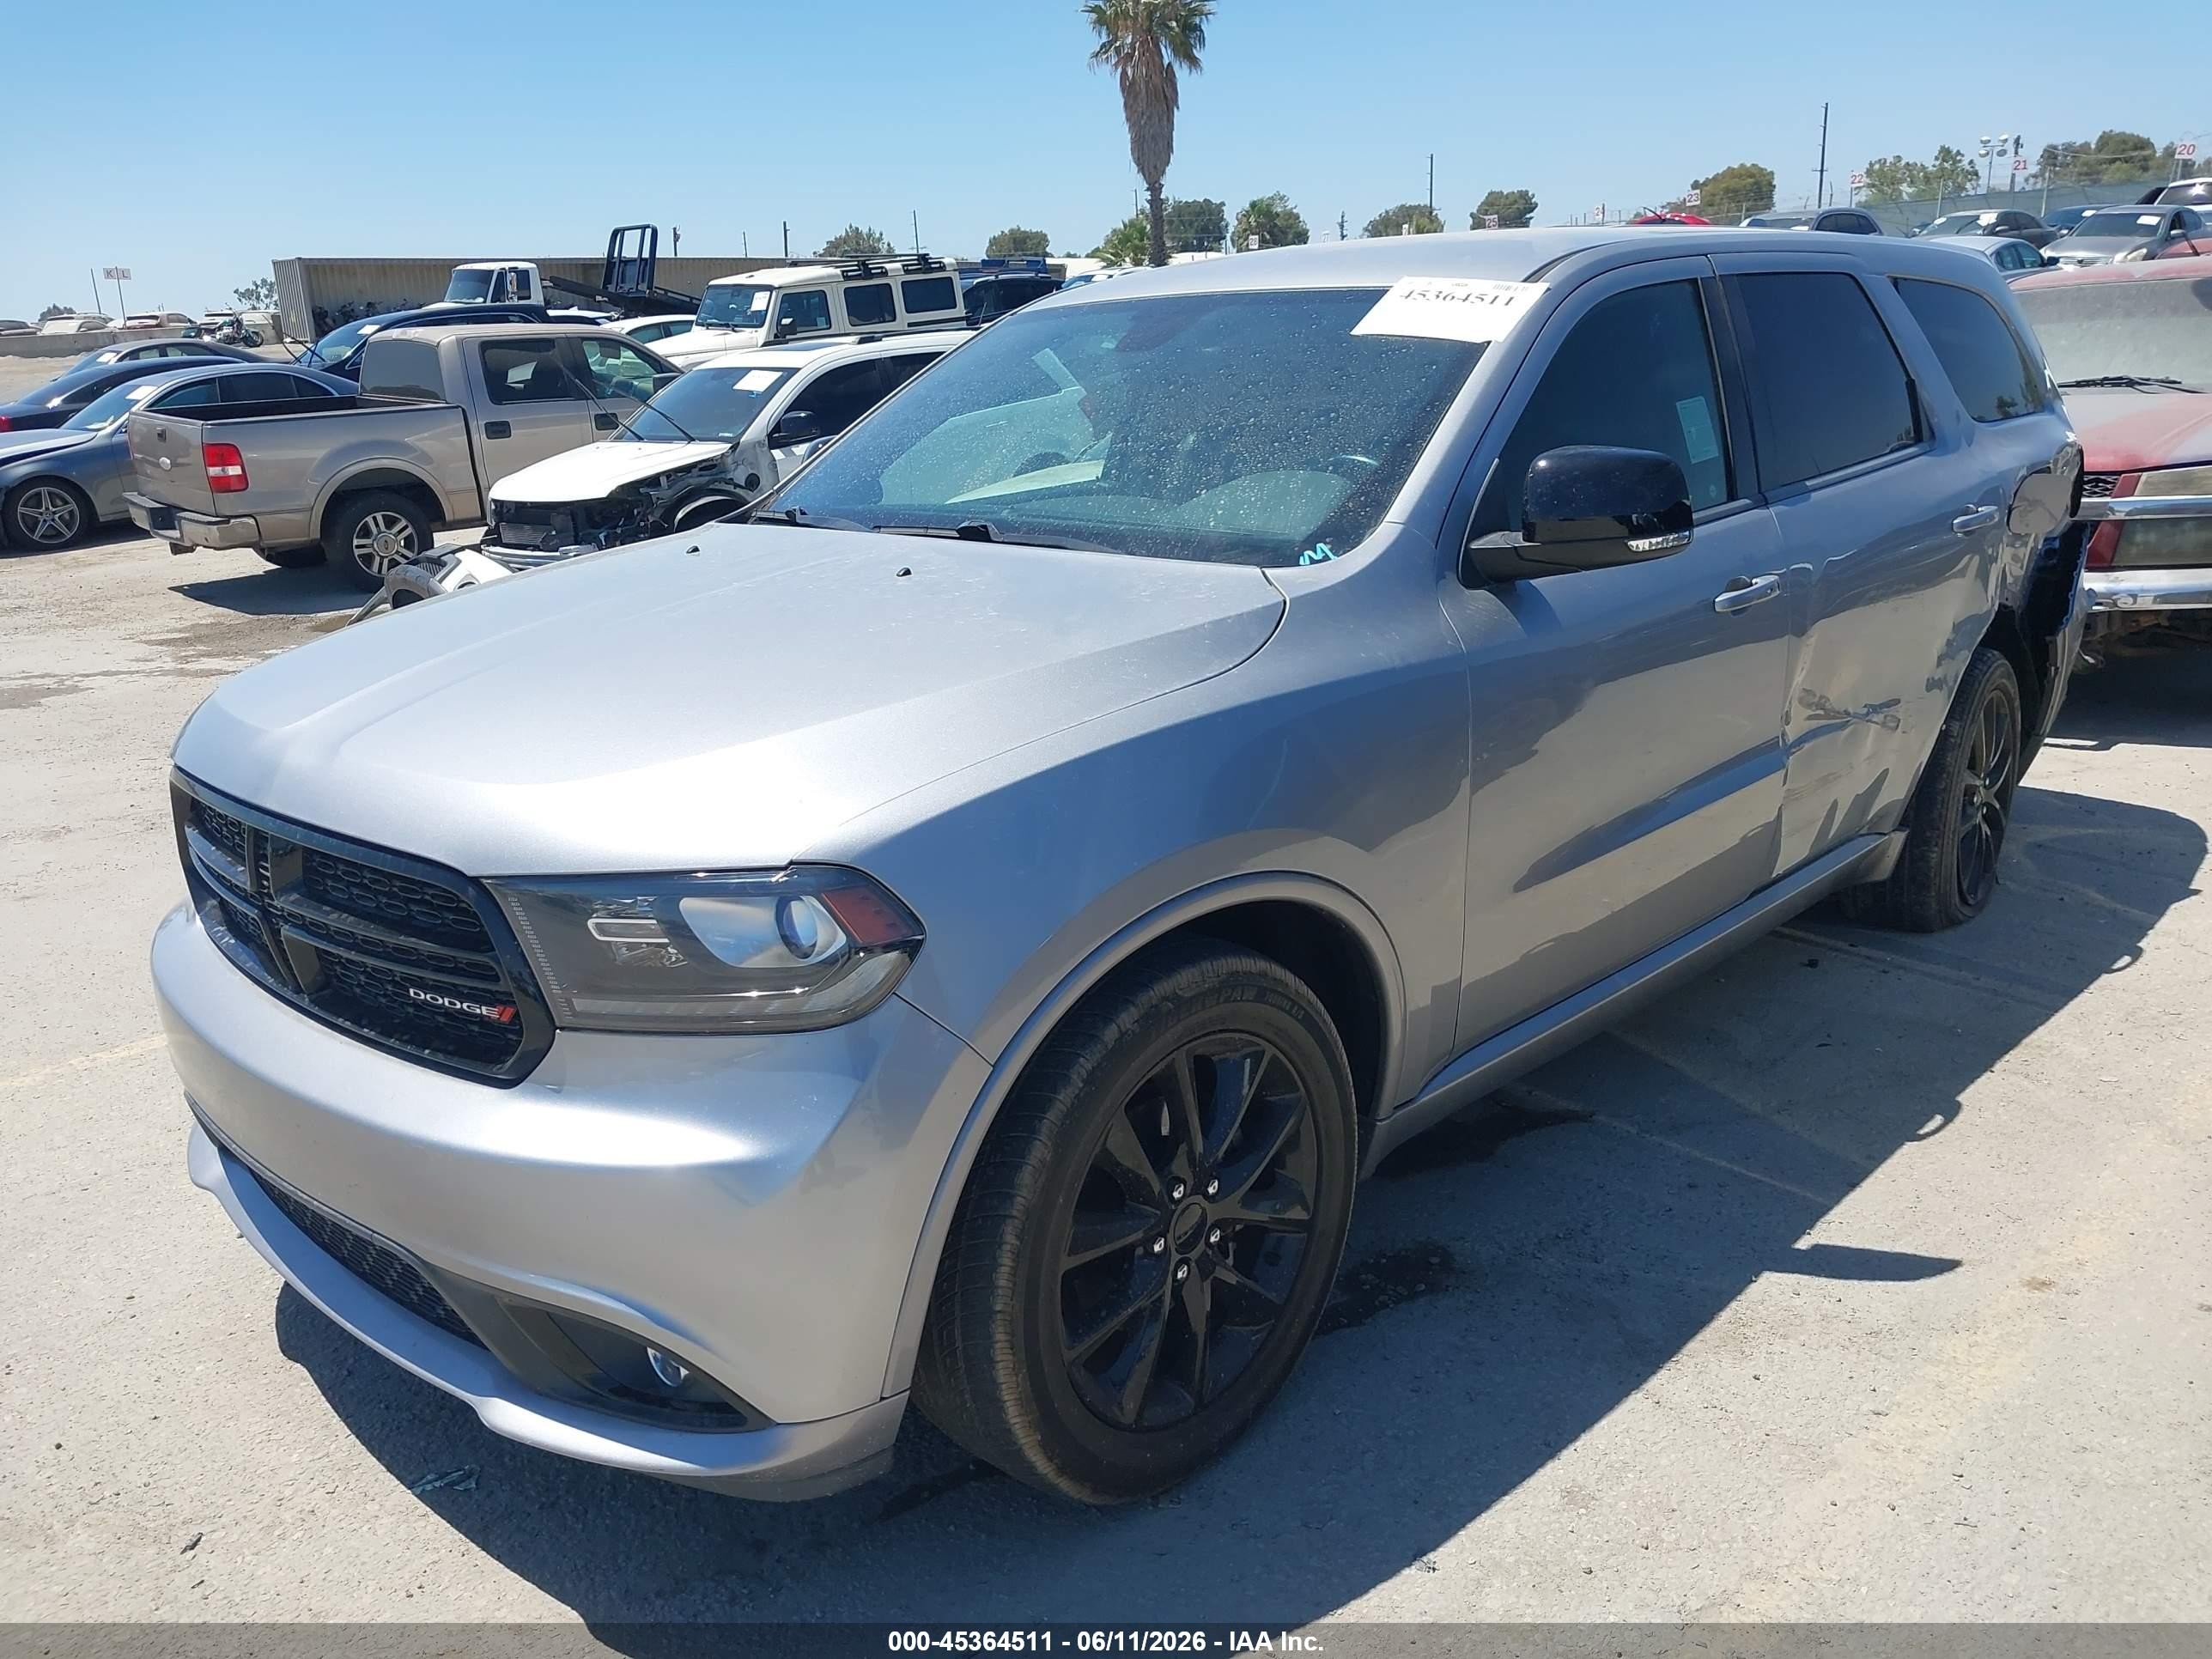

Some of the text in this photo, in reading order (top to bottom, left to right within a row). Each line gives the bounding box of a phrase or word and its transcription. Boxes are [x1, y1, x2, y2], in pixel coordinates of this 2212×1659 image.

[2178, 143, 2196, 155] 20
[2014, 160, 2027, 170] 21
[1850, 173, 1863, 185] 22
[1686, 193, 1699, 203] 23
[1486, 217, 1498, 228] 25
[106, 270, 129, 278] K L
[1400, 289, 1515, 307] 45364511
[409, 988, 501, 1018] DODGE
